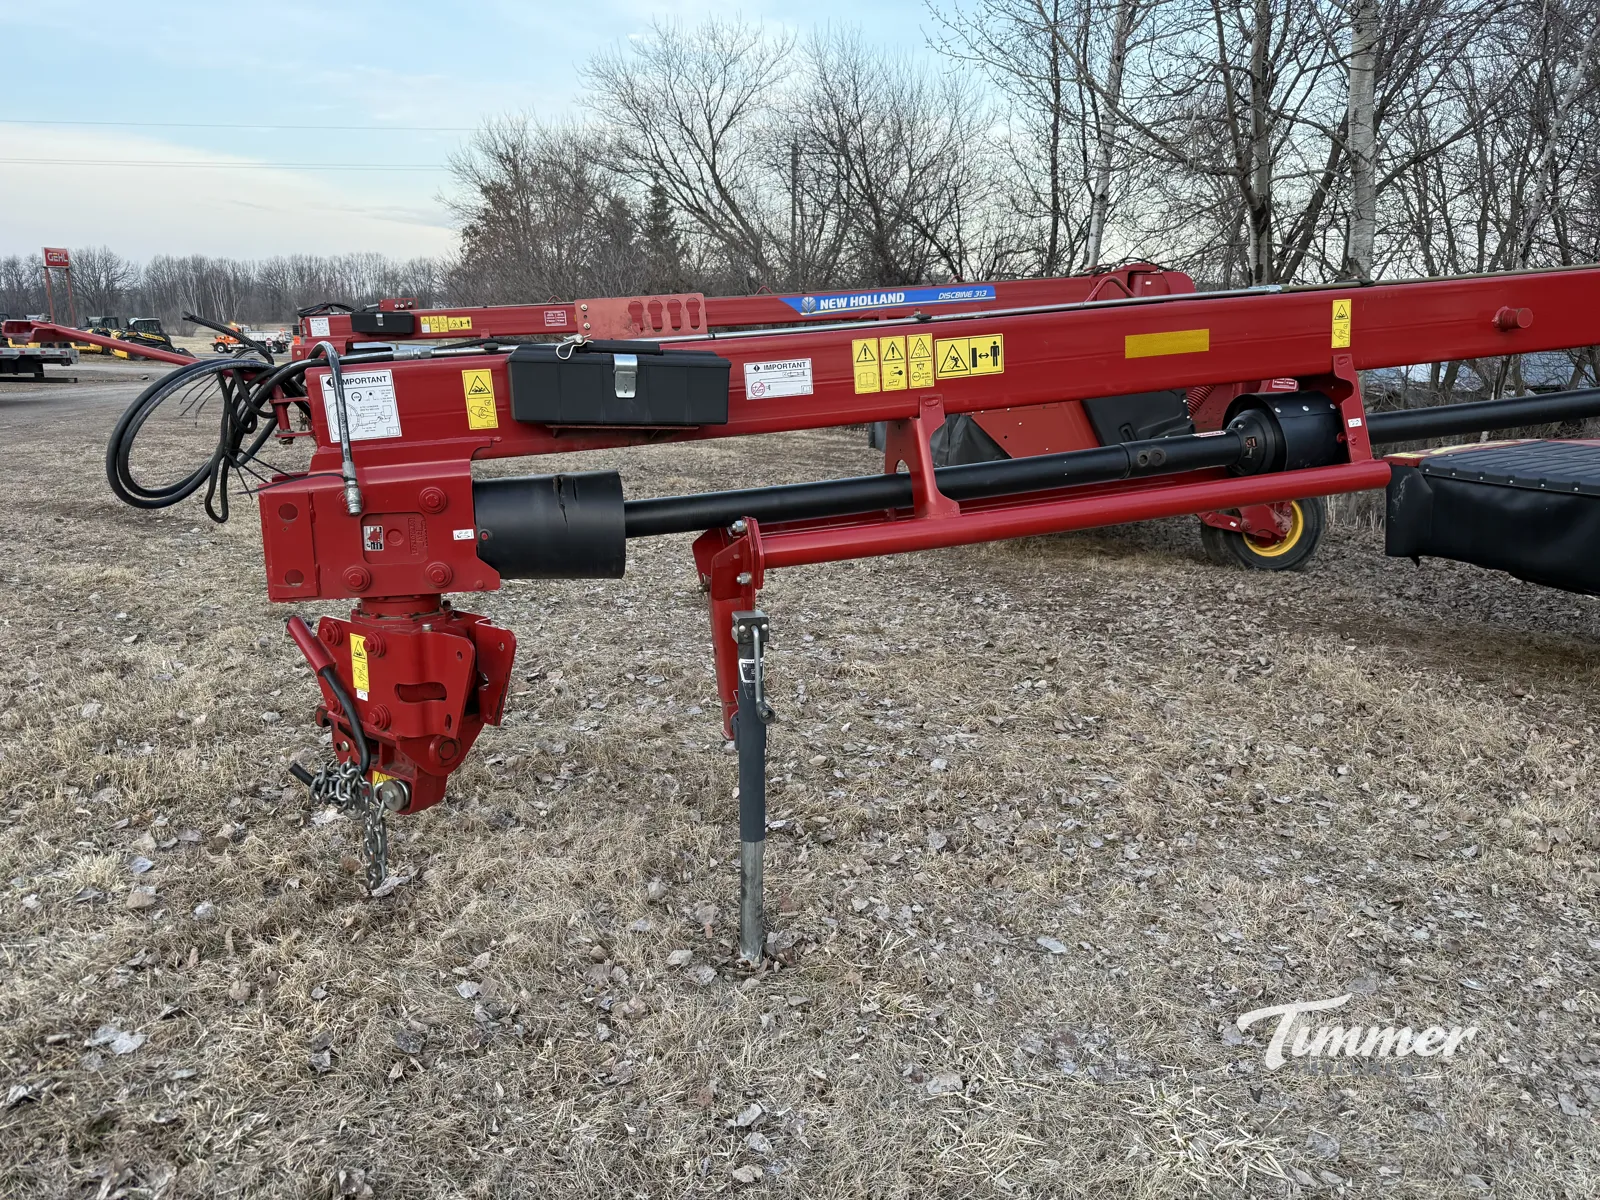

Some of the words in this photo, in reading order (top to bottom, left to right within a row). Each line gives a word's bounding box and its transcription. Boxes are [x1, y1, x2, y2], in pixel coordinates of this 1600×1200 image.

[47, 252, 68, 262] GEHL
[938, 290, 973, 300] DISCBINE
[973, 289, 987, 298] 313
[820, 296, 847, 310] NEW
[850, 292, 905, 307] HOLLAND
[763, 361, 806, 370] IMPORTANT
[342, 375, 387, 386] MPORTANT
